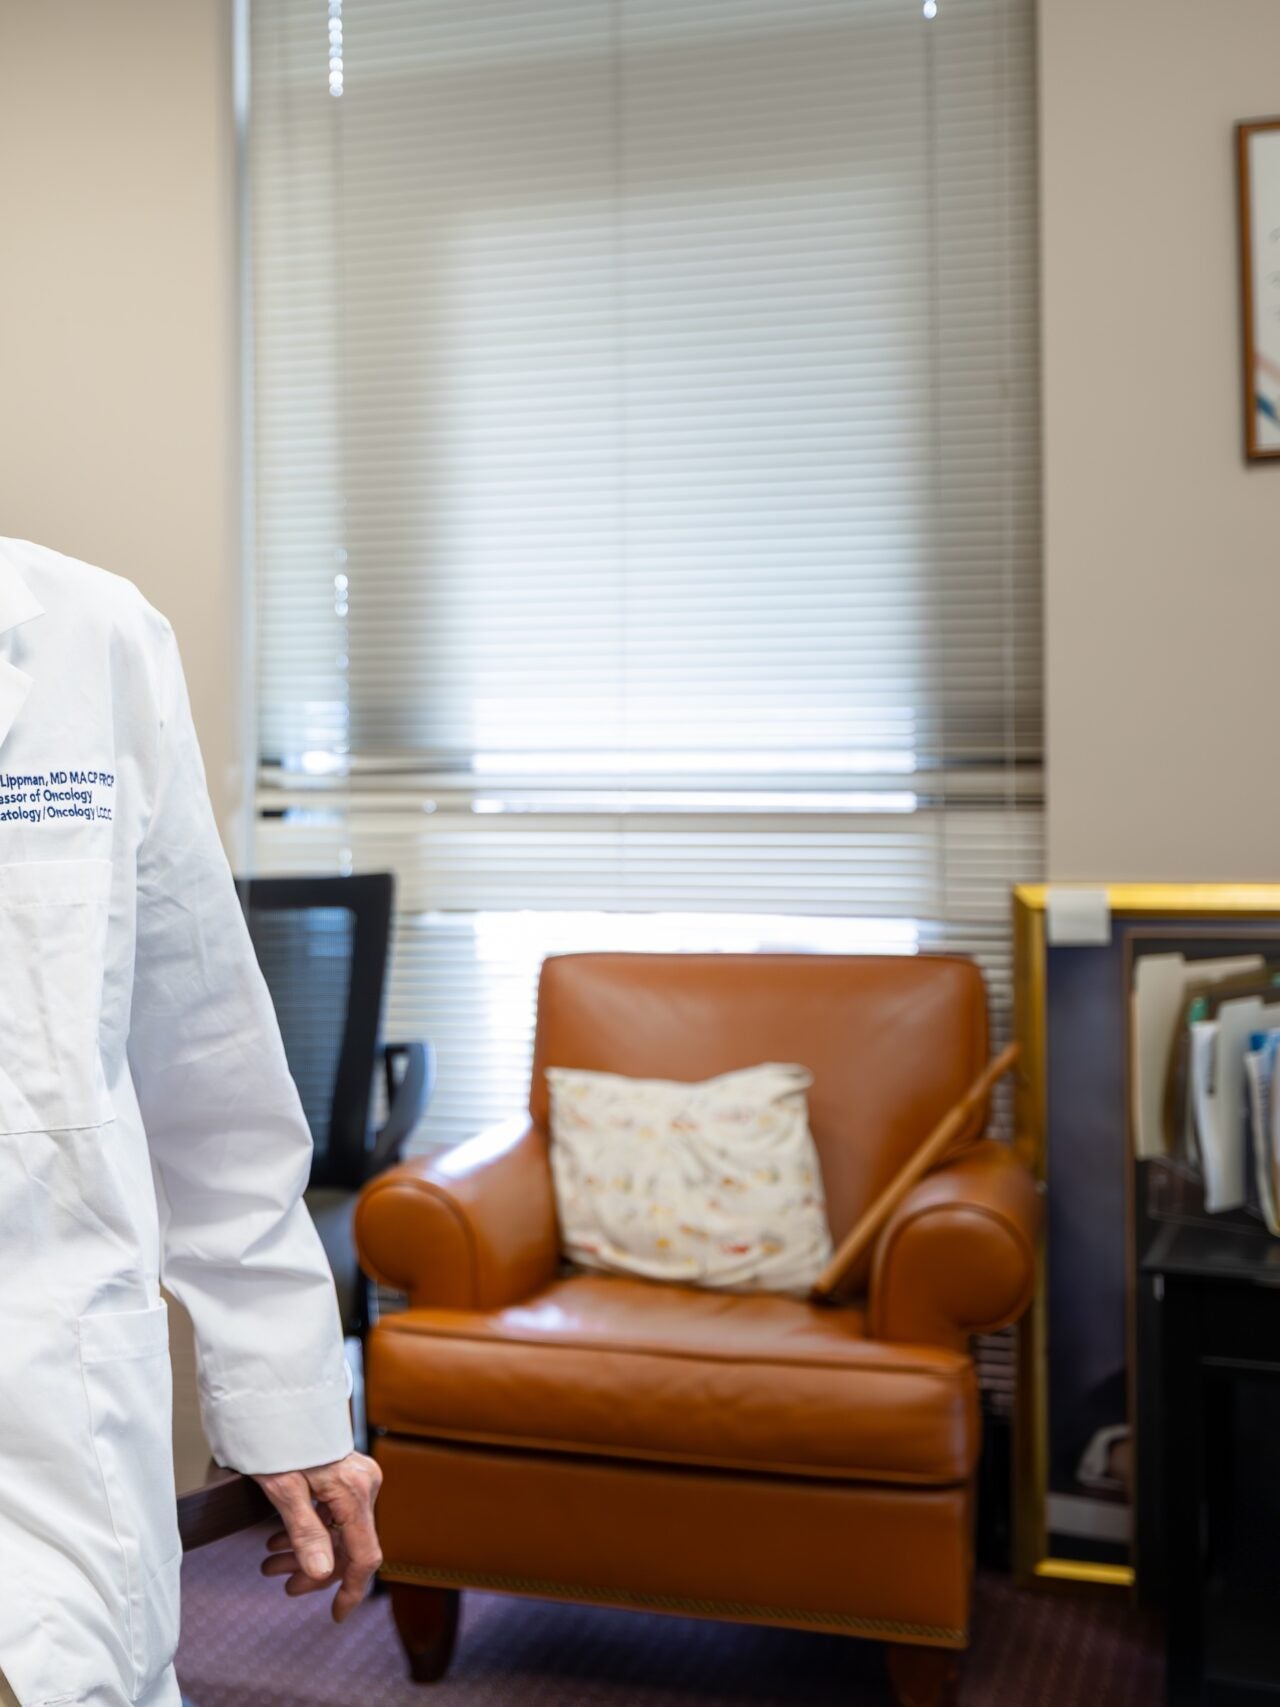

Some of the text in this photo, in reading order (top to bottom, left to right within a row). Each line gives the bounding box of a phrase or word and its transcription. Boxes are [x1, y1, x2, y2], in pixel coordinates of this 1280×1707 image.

[0, 773, 48, 790] Lippman,
[50, 771, 67, 785] MD
[30, 788, 41, 802] of
[43, 787, 92, 804] Oncology
